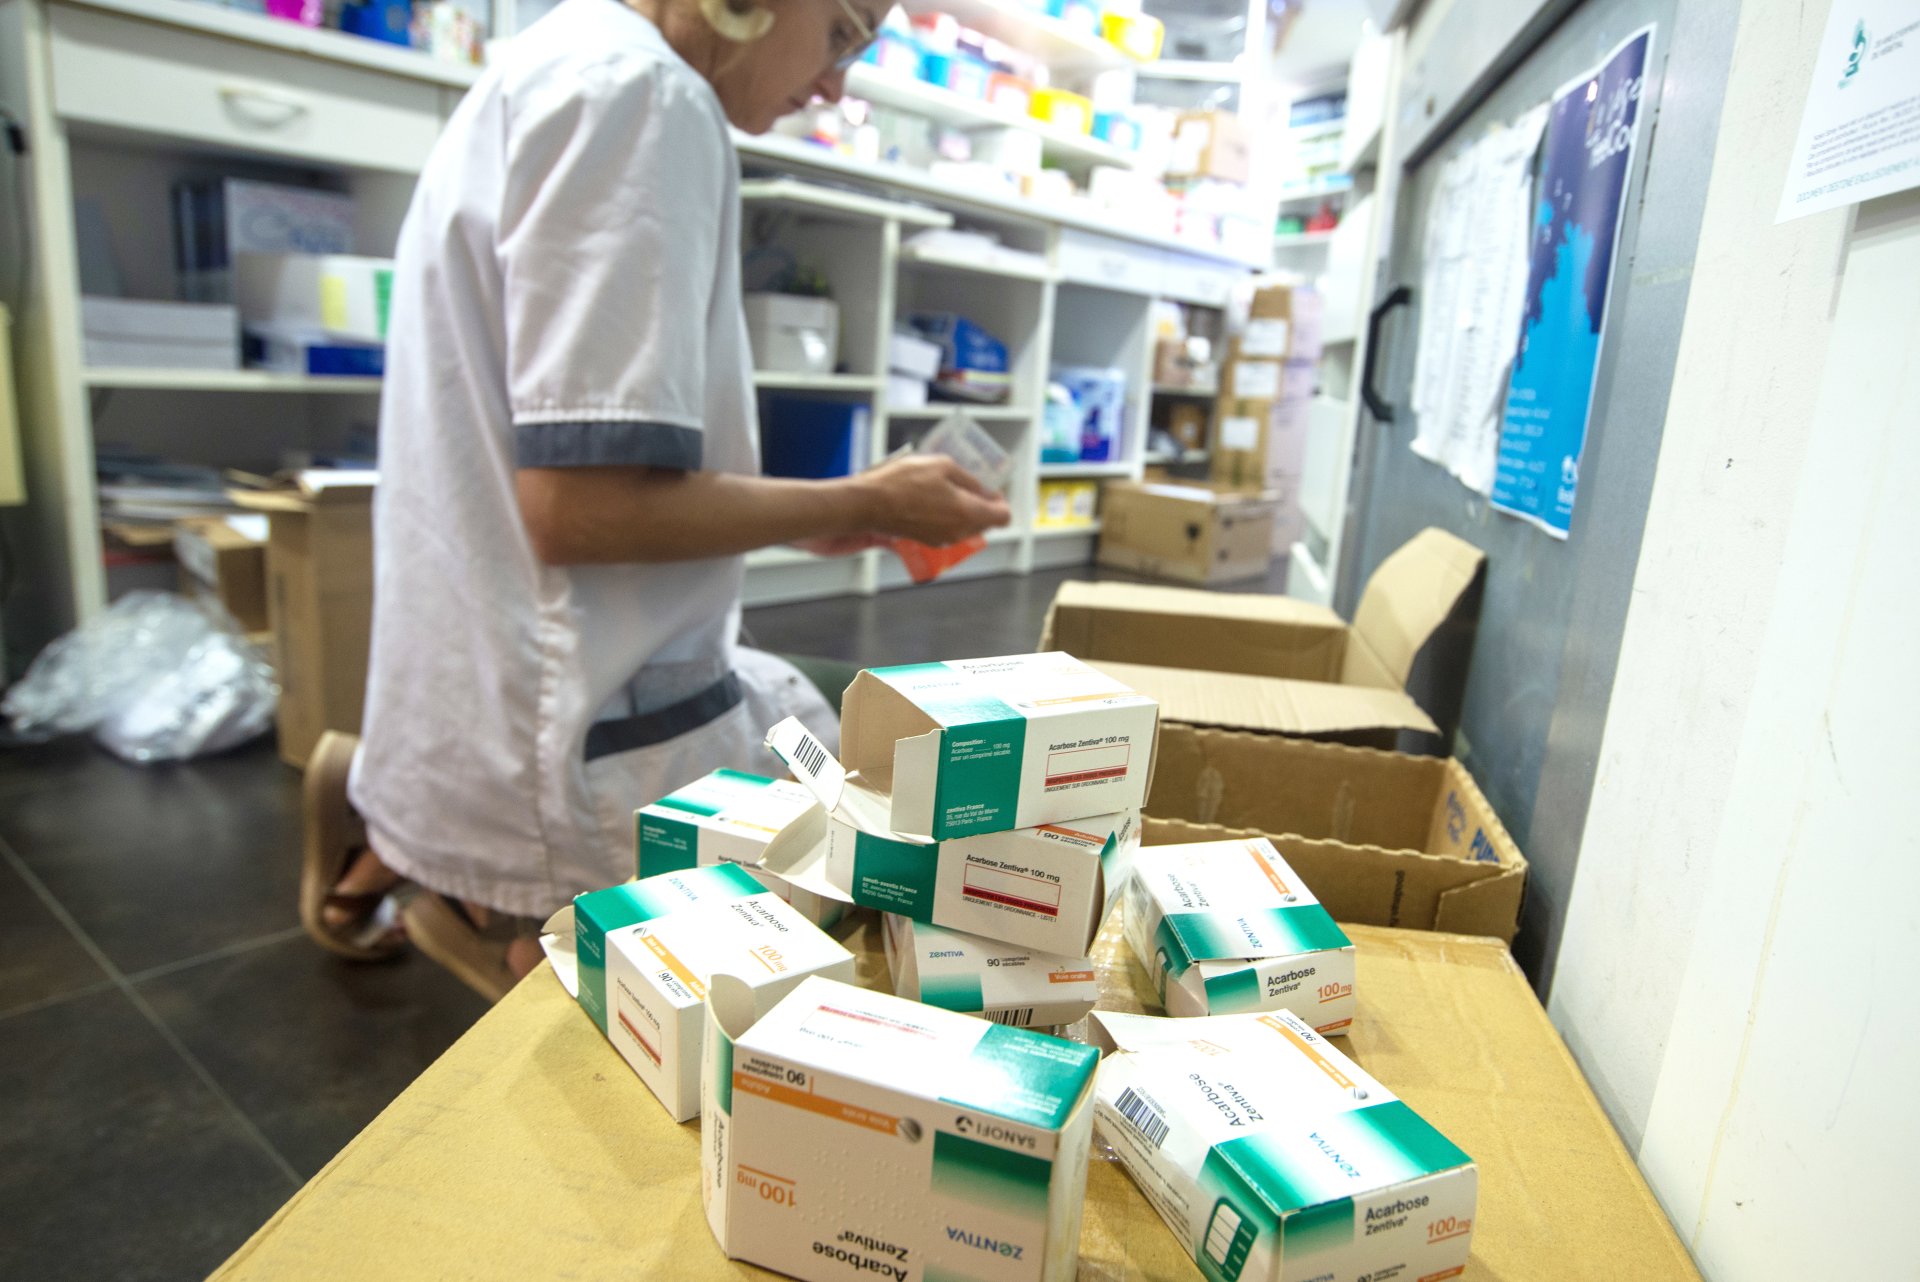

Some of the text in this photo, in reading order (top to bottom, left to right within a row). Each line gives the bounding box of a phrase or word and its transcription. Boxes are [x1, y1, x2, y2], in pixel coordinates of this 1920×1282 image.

[1048, 742, 1077, 751] Acarbose
[1104, 736, 1117, 744] 100
[1118, 735, 1130, 743] mg
[1043, 832, 1060, 840] 90
[966, 853, 998, 867] Acarbose
[1030, 869, 1046, 878] 100
[1046, 873, 1060, 883] mg
[746, 900, 789, 933] Acarbose
[758, 944, 784, 961] 100
[986, 958, 1000, 967] 90
[658, 972, 673, 982] 90
[1267, 967, 1316, 987] Acarbose
[1317, 982, 1352, 998] 100 mg
[1300, 1031, 1317, 1042] 90
[742, 1063, 784, 1081] comprimés
[786, 1069, 806, 1086] 90
[1188, 1073, 1246, 1128] Acarbose
[976, 1122, 1037, 1150] SANOFI
[736, 1170, 757, 1189] mg
[759, 1181, 797, 1208] 100
[1364, 1195, 1430, 1223] Acarbose
[1426, 1216, 1473, 1239] 100 mg
[811, 1241, 909, 1282] Acarbose
